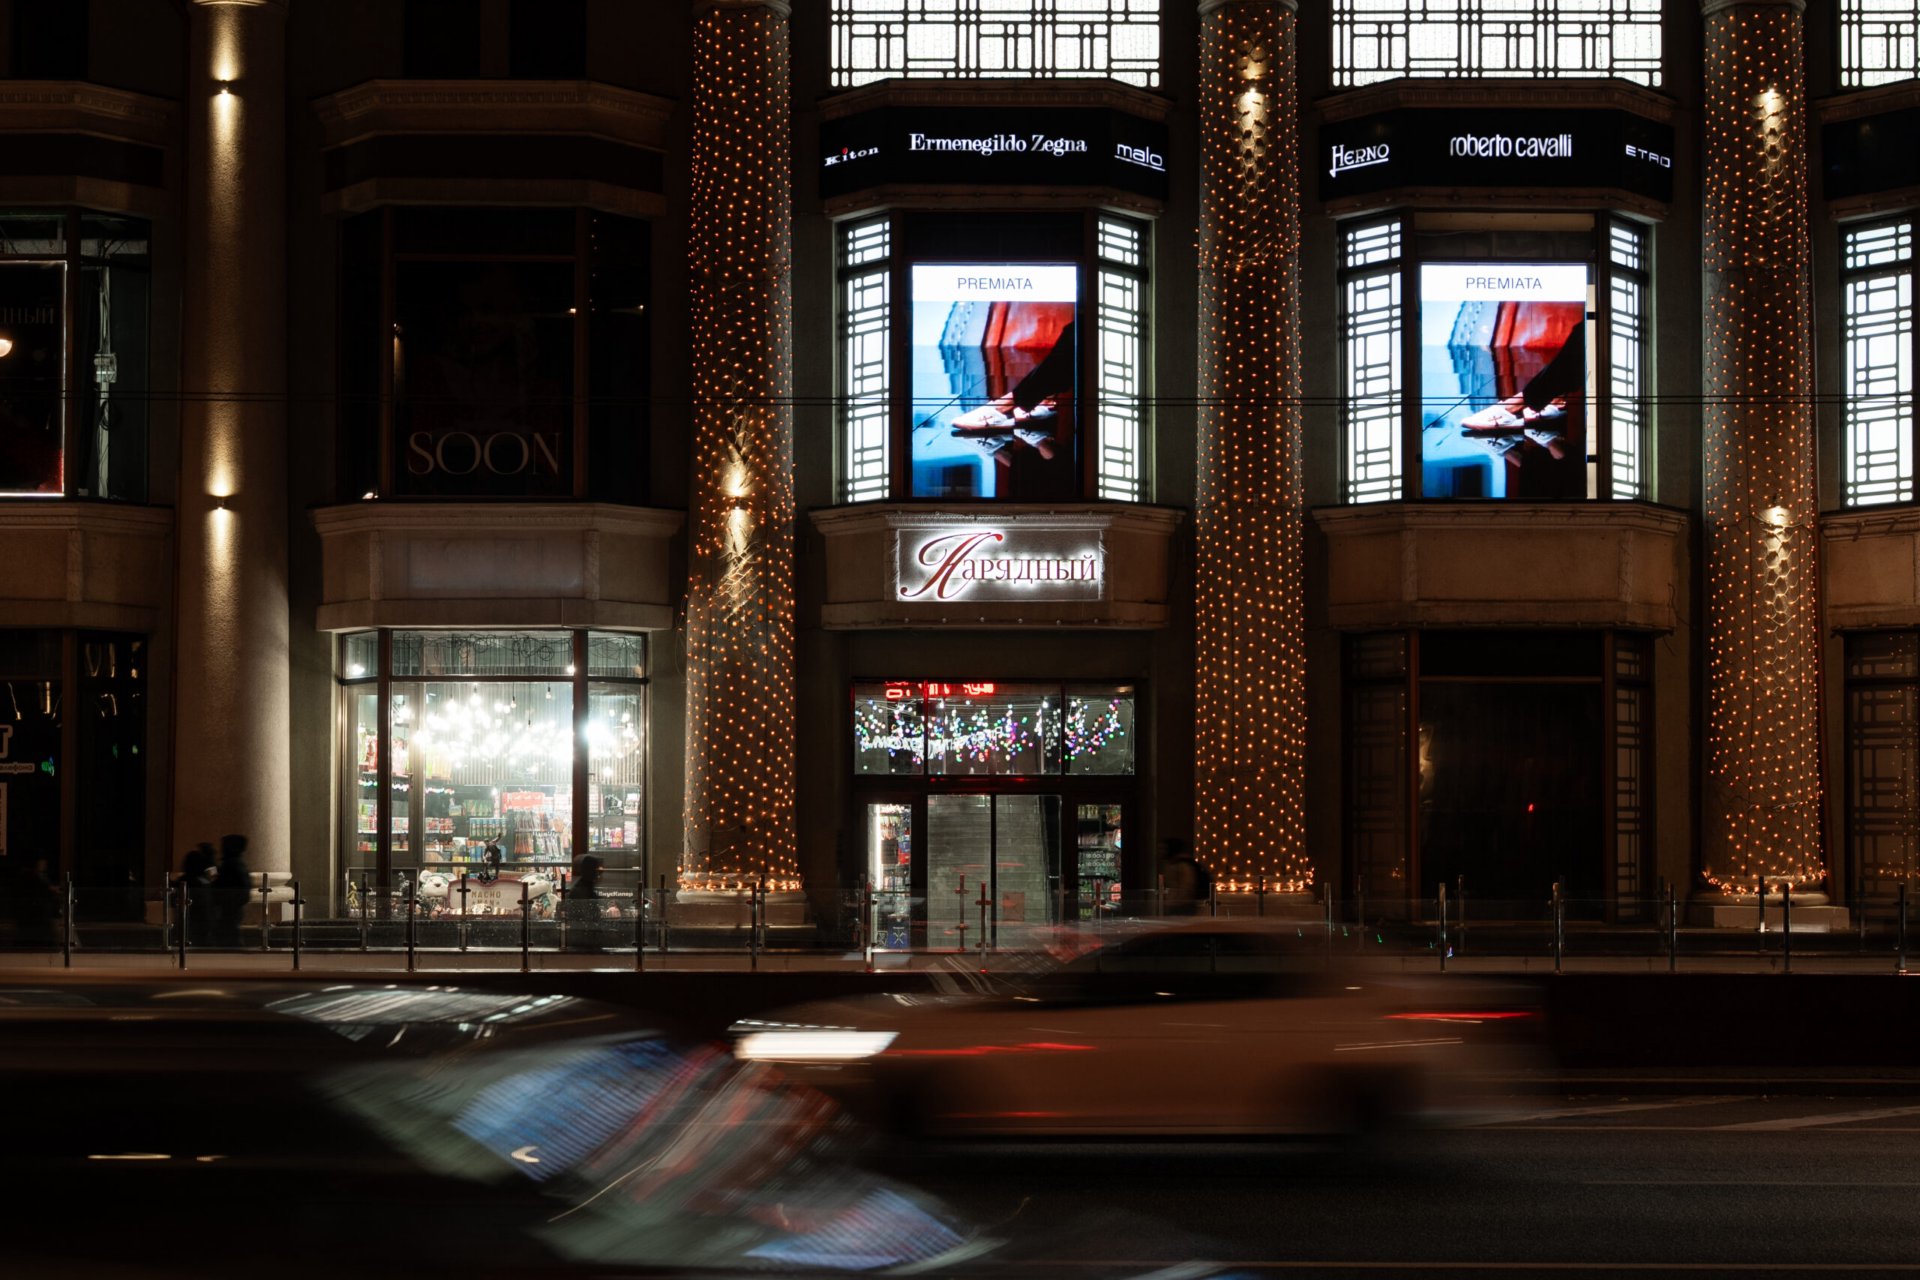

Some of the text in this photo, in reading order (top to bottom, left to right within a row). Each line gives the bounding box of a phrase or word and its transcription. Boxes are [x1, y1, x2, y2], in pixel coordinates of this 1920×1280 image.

[909, 133, 1088, 156] Ermenegildo Zegna
[1115, 143, 1164, 168] malo
[1449, 133, 1573, 157] roberto cavalli
[1625, 144, 1671, 168] ETRO
[824, 147, 879, 167] Kiton
[957, 277, 1033, 290] PREMIATA
[1465, 277, 1543, 290] PREMIATA
[407, 431, 562, 475] SOON
[900, 532, 1098, 599] Нарядный
